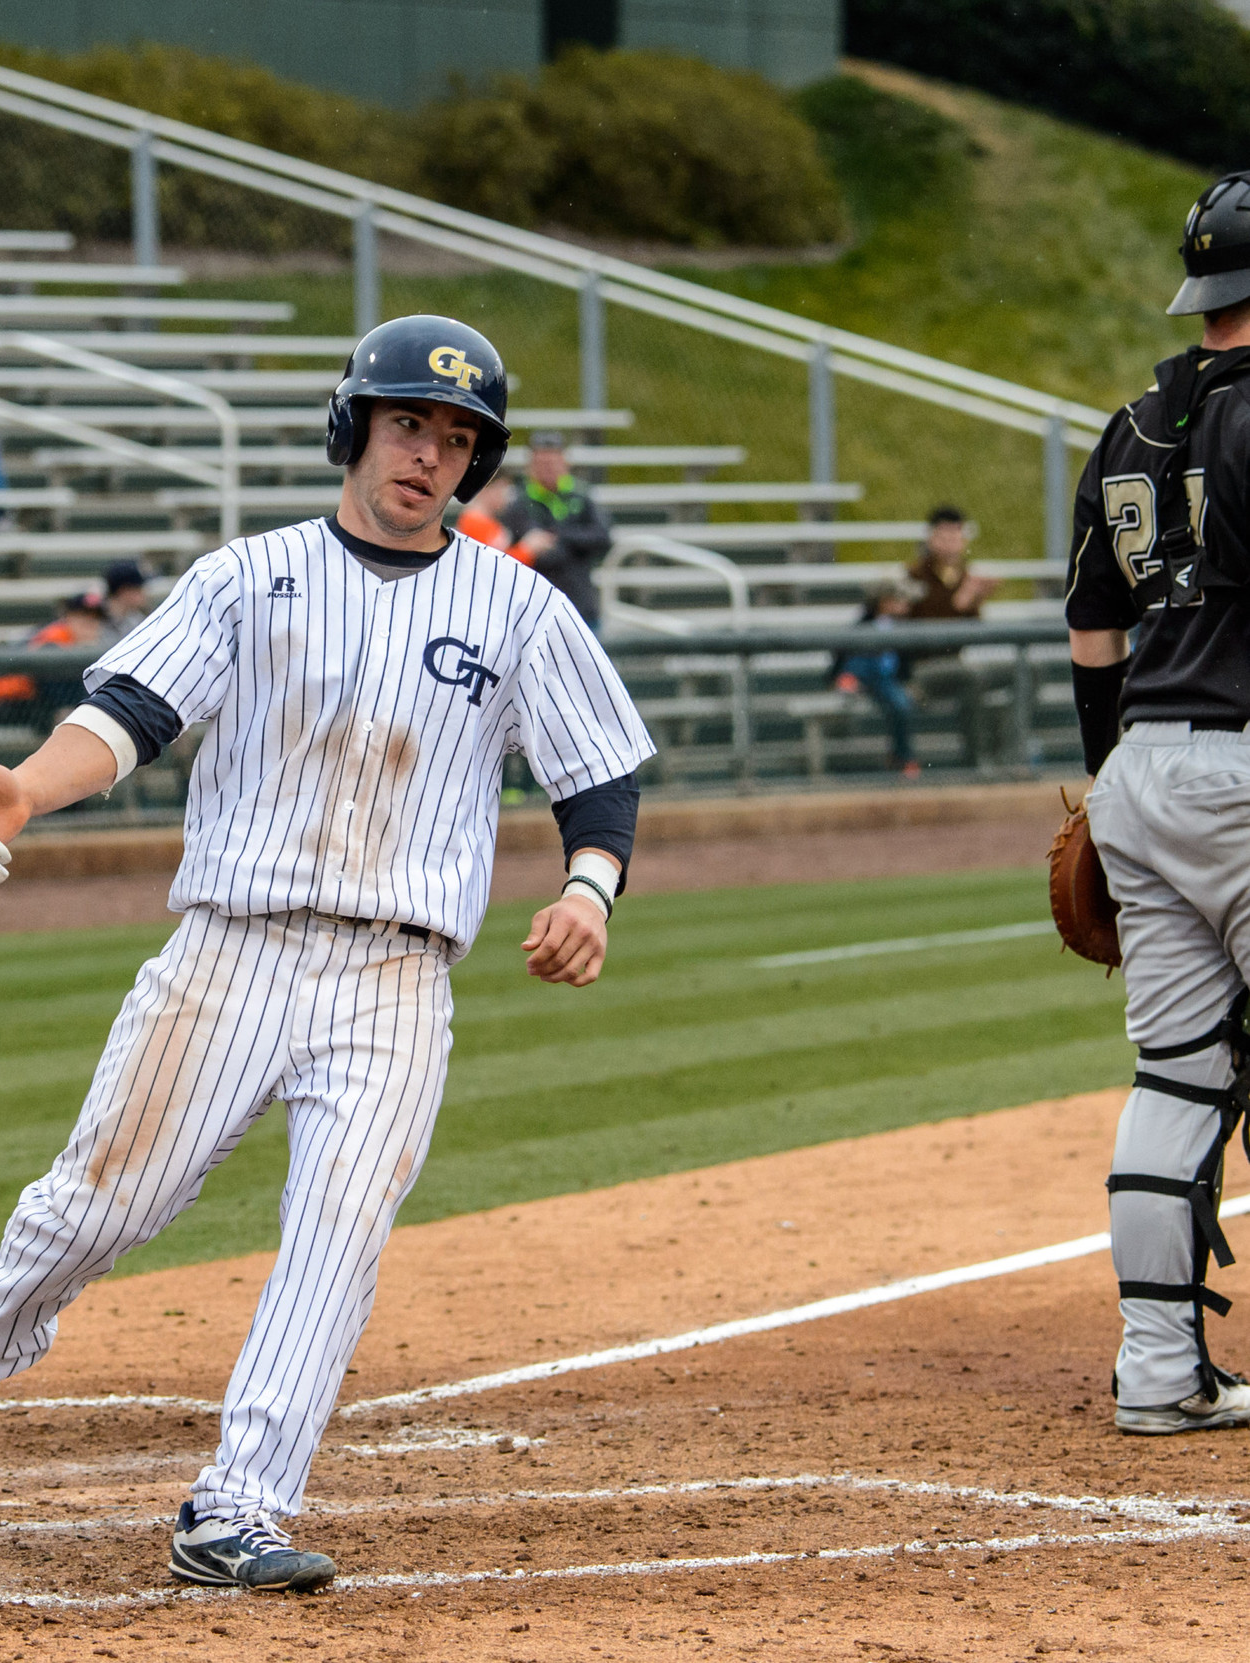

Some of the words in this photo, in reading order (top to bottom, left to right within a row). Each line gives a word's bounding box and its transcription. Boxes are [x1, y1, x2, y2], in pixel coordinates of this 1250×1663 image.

[428, 346, 483, 391] GT
[273, 577, 295, 591] R
[423, 636, 500, 707] GT
